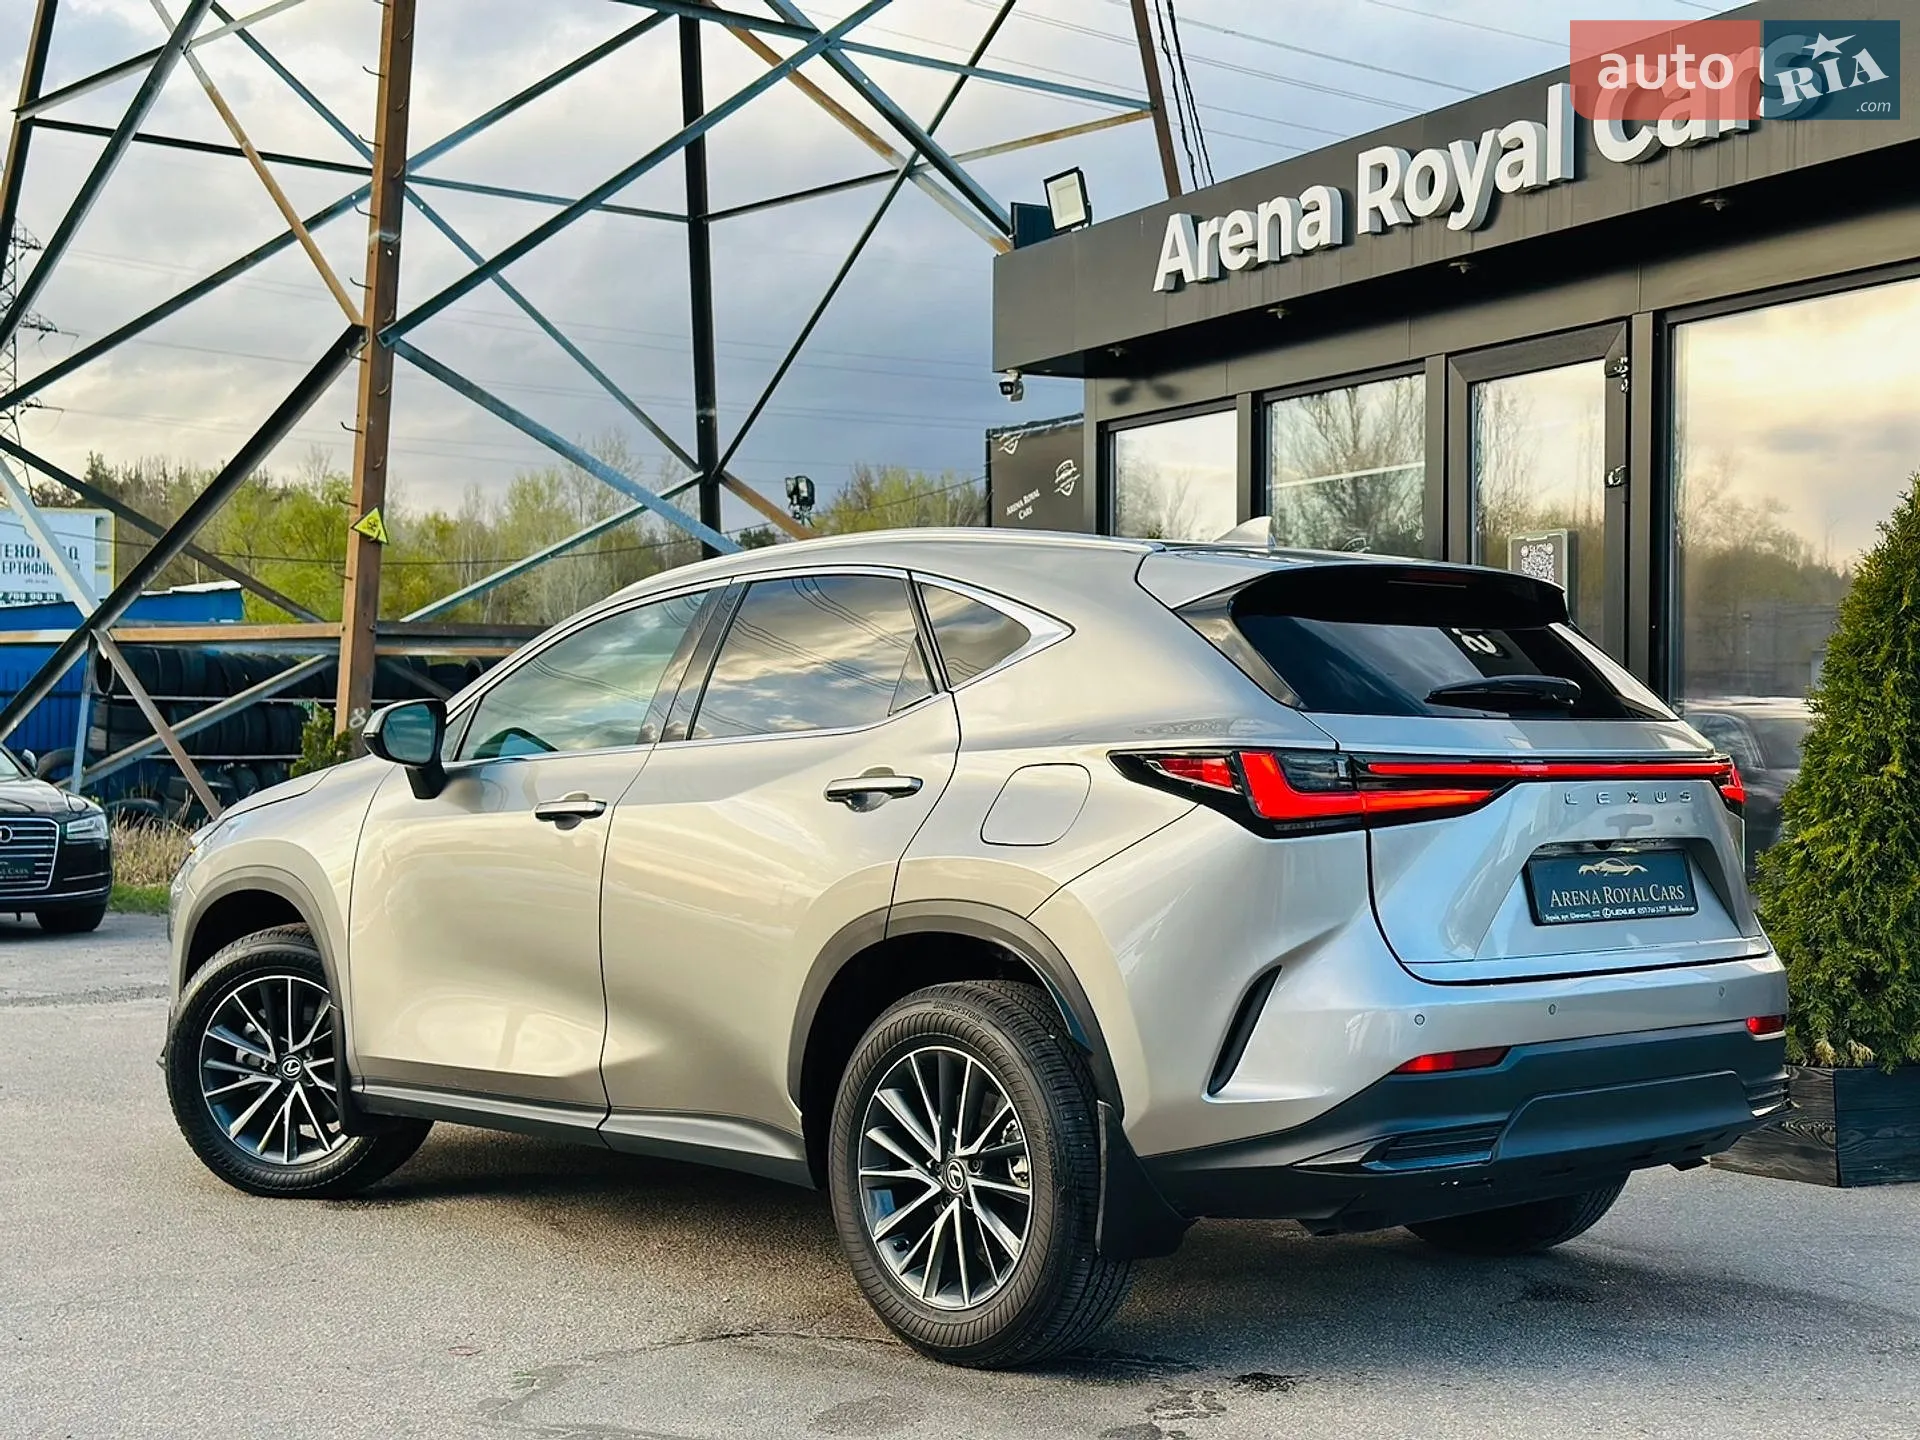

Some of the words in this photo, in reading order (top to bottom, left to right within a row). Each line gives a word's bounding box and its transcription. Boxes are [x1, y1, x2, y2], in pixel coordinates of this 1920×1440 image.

[1153, 185, 1343, 292] Arena
[1357, 82, 1575, 234] Royal
[1563, 791, 1692, 805] LEXUS
[1550, 889, 1601, 907] ARENA
[1602, 886, 1649, 904] ROYAL
[1649, 883, 1686, 902] CARS
